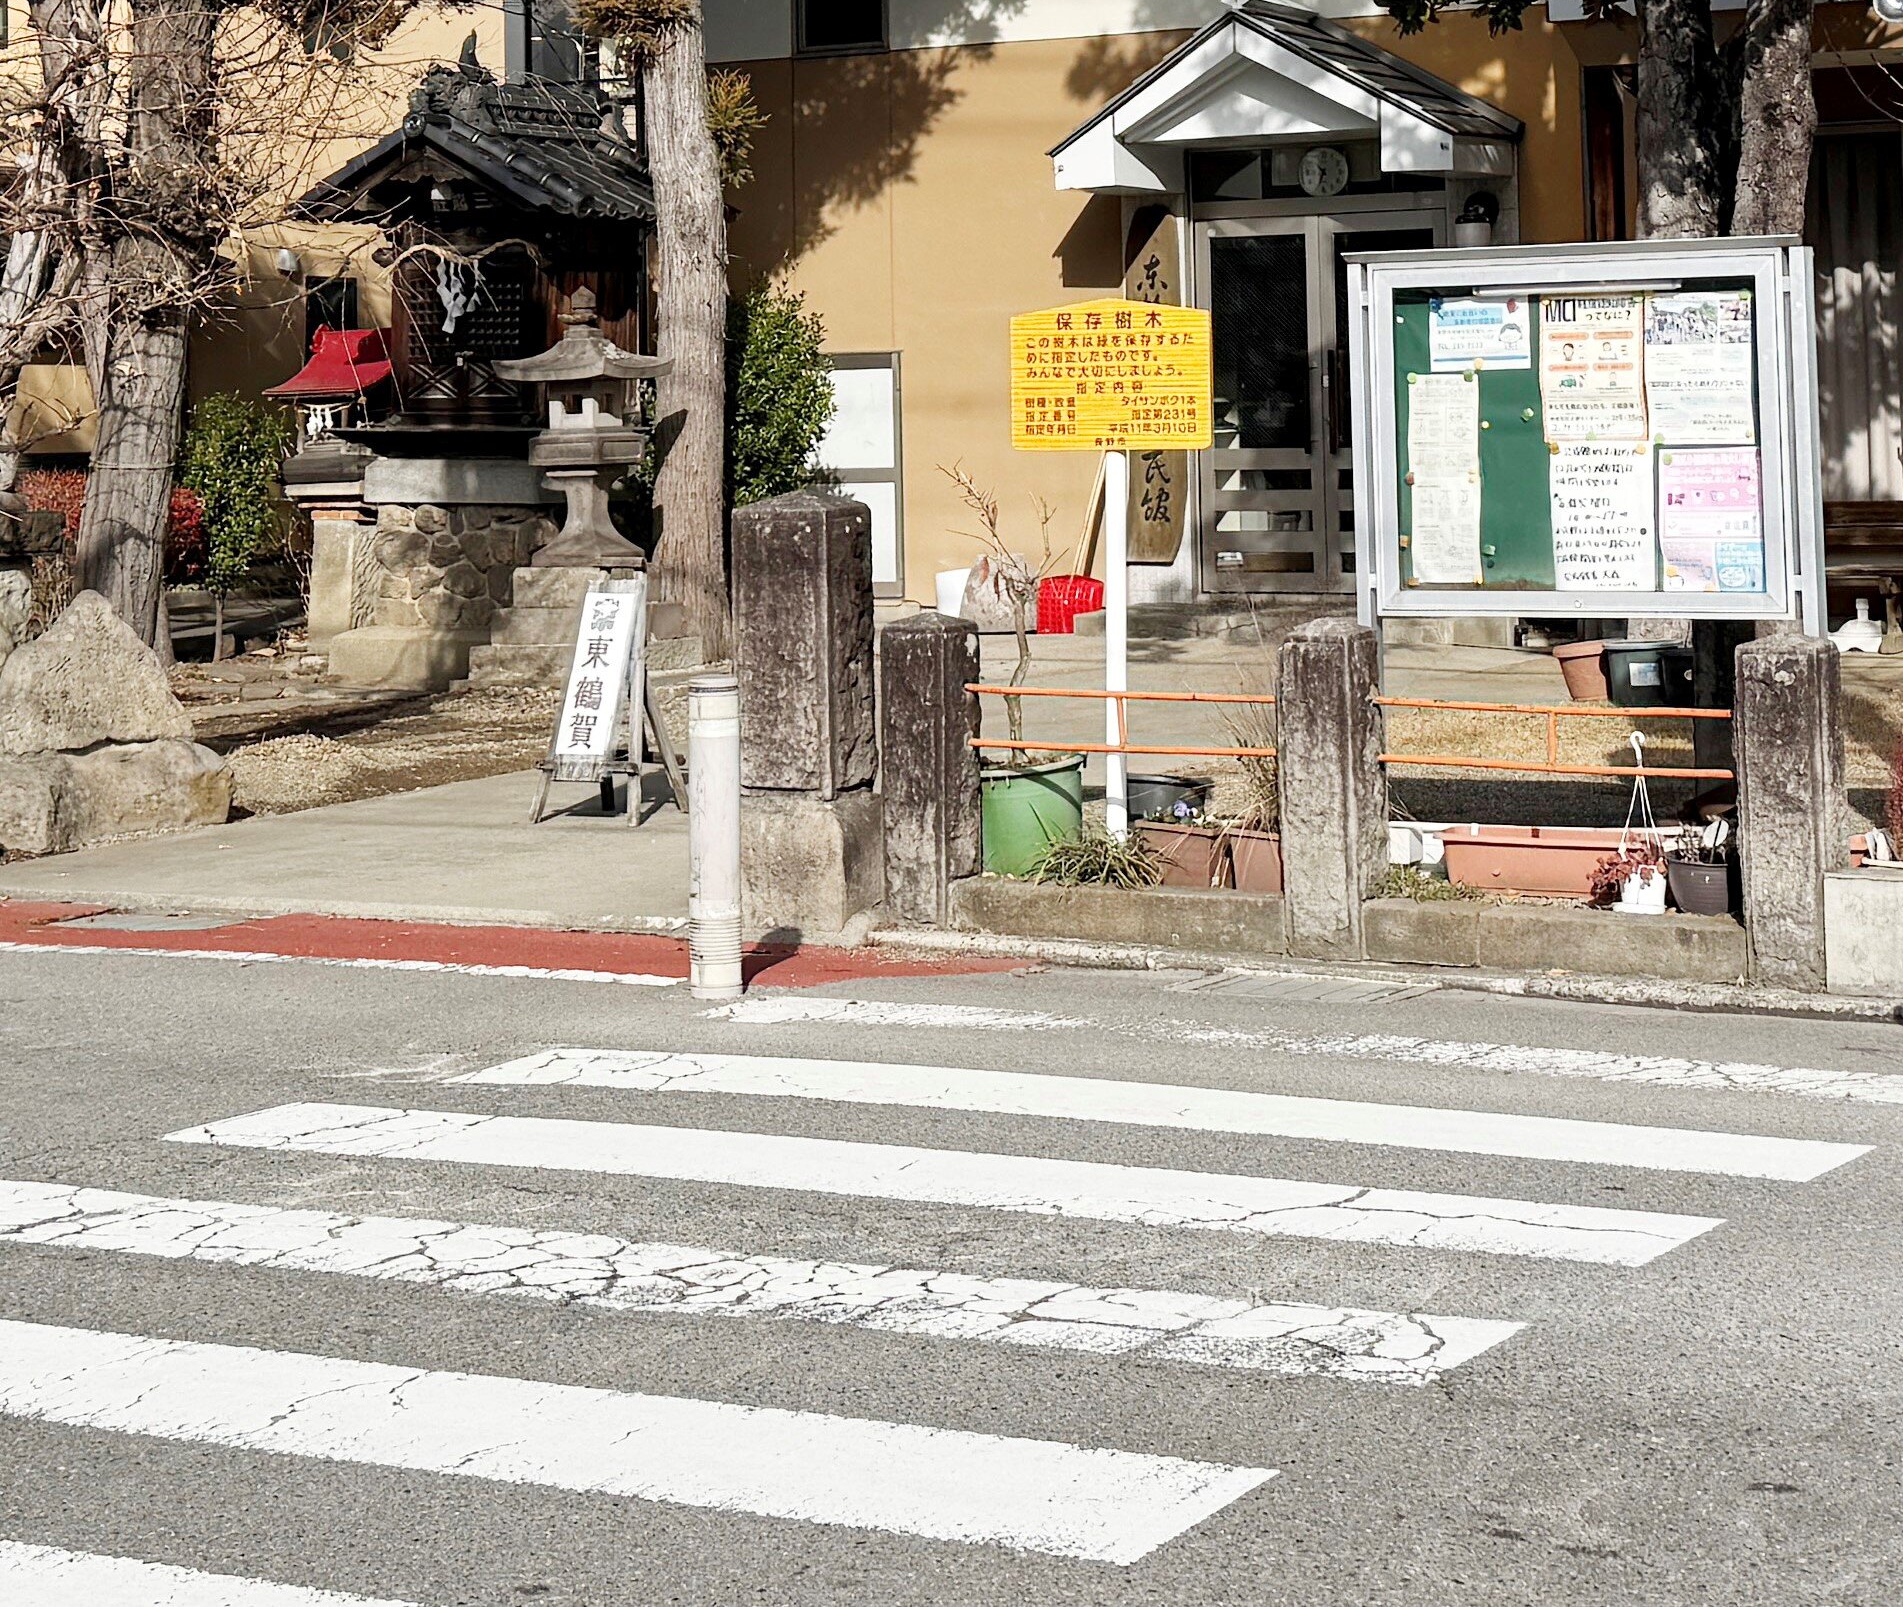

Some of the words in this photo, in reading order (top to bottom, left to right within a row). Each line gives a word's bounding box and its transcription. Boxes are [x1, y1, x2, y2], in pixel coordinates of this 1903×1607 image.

[1545, 299, 1577, 323] MCI
[1056, 312, 1163, 331] 保存樹木
[1026, 333, 1194, 349] この樹木は緑を保存するた
[1026, 350, 1159, 364] めに指定したものです。
[1026, 364, 1184, 378] みんなで大切にしましょう。
[1076, 380, 1144, 394] 指定内容
[1025, 397, 1076, 408] 樹種・数量
[1121, 395, 1197, 406] タイサンボク1本
[1025, 410, 1076, 422] 指定番号
[1131, 408, 1196, 420] 指定第231号
[1025, 423, 1076, 435] 指定年月日
[1108, 422, 1197, 434] 平成11年3月10日
[1094, 437, 1127, 447] 長野市
[567, 635, 614, 749] 東鶴賀
